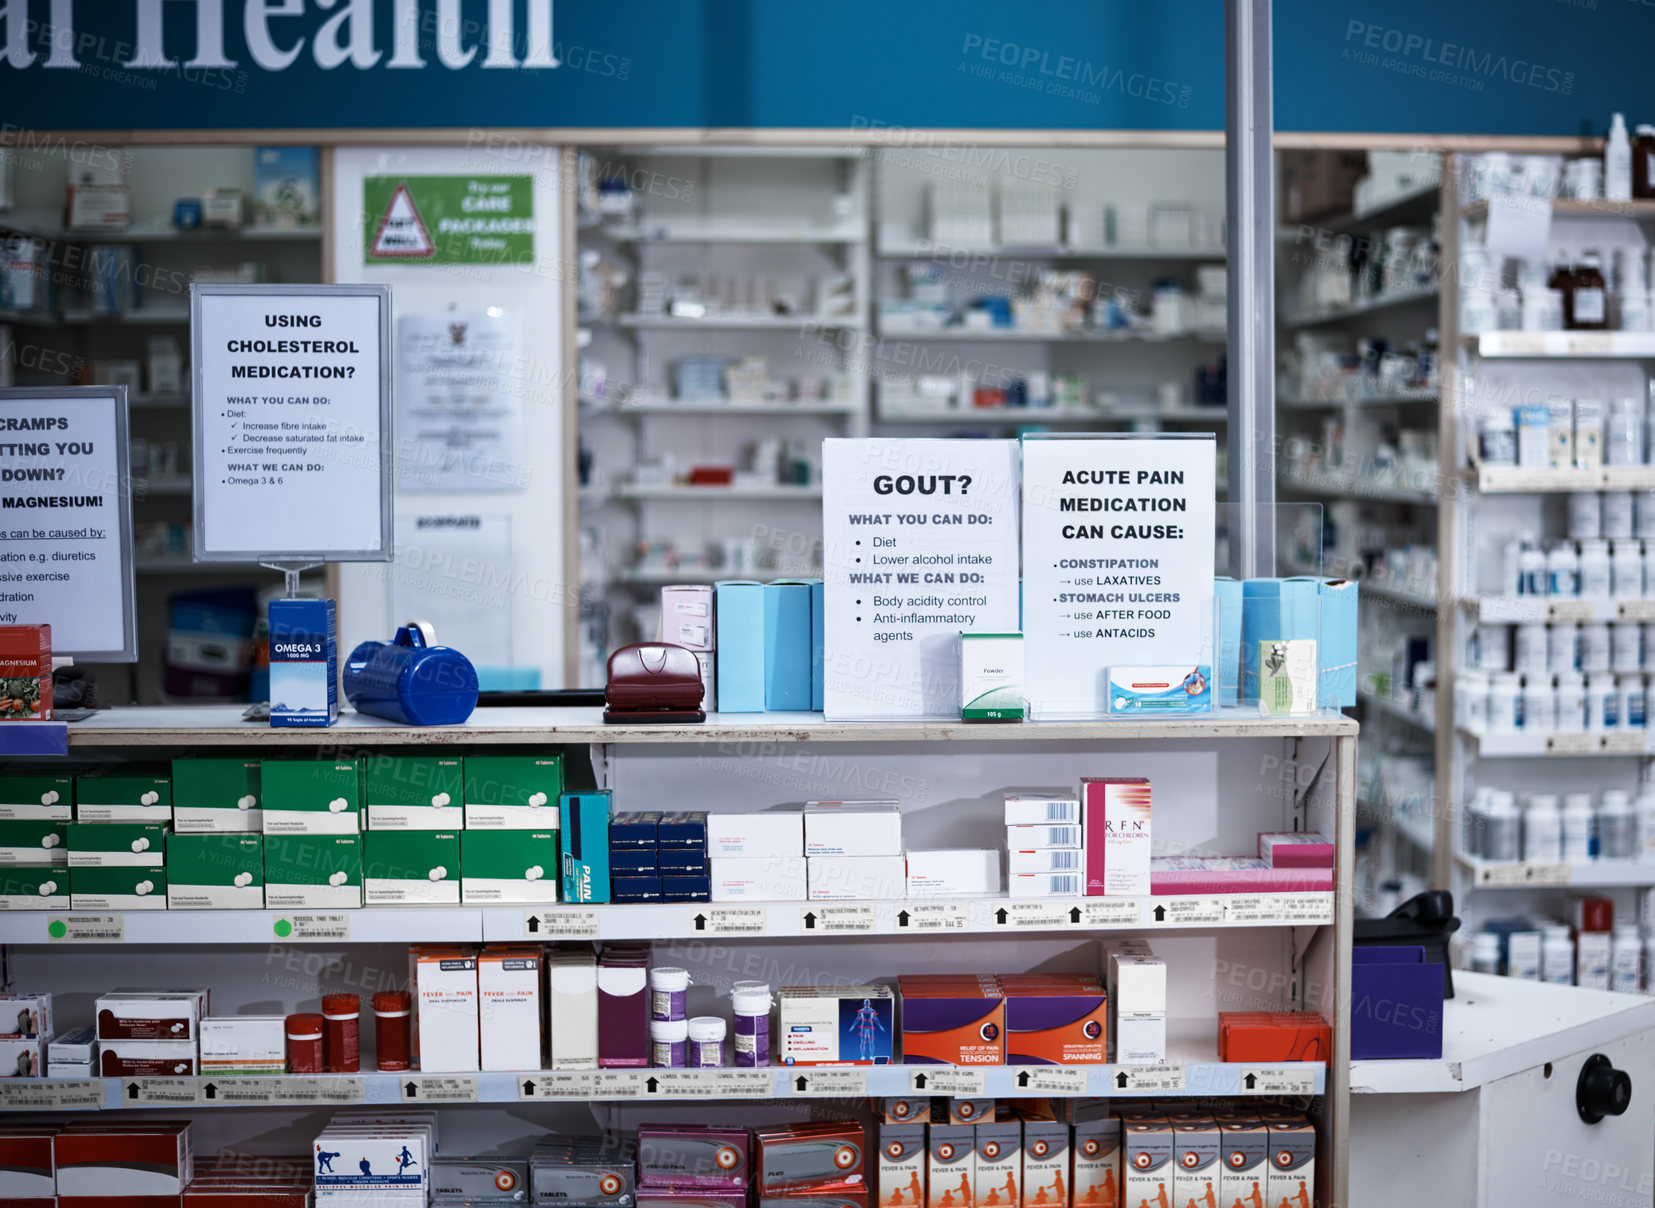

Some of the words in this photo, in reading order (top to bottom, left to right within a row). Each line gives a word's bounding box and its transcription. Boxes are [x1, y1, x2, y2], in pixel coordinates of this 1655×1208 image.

[264, 314, 322, 328] USING
[226, 339, 360, 354] CHOLESTEROL
[231, 365, 356, 379] MEDICATION?
[226, 396, 259, 405] WHAT
[261, 396, 285, 405] YOU
[287, 396, 310, 405] CAN
[312, 396, 331, 405] DO:
[226, 409, 248, 419] Diet:
[242, 421, 279, 431] Increase
[280, 421, 300, 431] fibre
[301, 422, 327, 431] intake
[242, 433, 284, 443] Decrease
[285, 434, 325, 443] saturated
[326, 433, 338, 443] fat
[339, 434, 365, 443] intake
[54, 441, 94, 456] YOU
[227, 445, 264, 455] Exercise
[265, 445, 308, 456] frequently
[227, 463, 260, 472] WHAT
[261, 463, 278, 472] WE
[280, 463, 304, 472] CAN
[306, 463, 325, 472] DO:
[1, 467, 66, 482] DOWN?
[1061, 470, 1131, 485] ACUTE
[1136, 470, 1184, 485] PAIN
[227, 476, 259, 487] Omega
[261, 476, 267, 485] 3
[268, 476, 276, 485] &
[277, 476, 284, 485] 6
[873, 474, 973, 496] GOUT?
[1, 495, 103, 509] MAGNESIUM!
[1059, 497, 1187, 512] MEDICATION
[848, 514, 893, 526] WHAT
[895, 513, 928, 526] YOU
[931, 513, 963, 525] CAN
[967, 513, 993, 525] DO:
[9, 529, 30, 539] can
[31, 528, 46, 539] be
[48, 528, 88, 539] caused
[89, 527, 106, 541] by:
[1061, 524, 1104, 540] CAN
[1110, 524, 1184, 540] CAUSE:
[872, 536, 897, 548] Diet
[28, 553, 49, 564] e.g.
[51, 551, 96, 562] diuretics
[873, 554, 910, 565] Lower
[912, 553, 954, 565] alcohol
[957, 553, 993, 565] intake
[1059, 558, 1159, 569] CONSTIPATION
[25, 571, 70, 582] exercise
[848, 572, 893, 584] WHAT
[896, 572, 920, 584] WE
[923, 572, 955, 584] CAN
[959, 572, 985, 584] DO:
[1074, 578, 1094, 586] use
[1096, 575, 1161, 586] LAXATIVES
[873, 595, 904, 609] Body
[906, 595, 945, 609] acidity
[947, 595, 987, 607] control
[1059, 592, 1125, 603] STOMACH
[1128, 592, 1181, 603] ULCERS
[873, 612, 976, 626] Anti-inflammatory
[1073, 612, 1093, 620] use
[1095, 609, 1135, 620] AFTER
[1137, 609, 1171, 620] FOOD
[873, 630, 914, 644] agents
[1073, 630, 1093, 638] use
[1095, 628, 1156, 638] ANTACIDS
[275, 644, 312, 653] OMEGA
[315, 644, 321, 653] 3
[582, 865, 592, 900] PAIN
[1063, 1053, 1102, 1061] SPANNING
